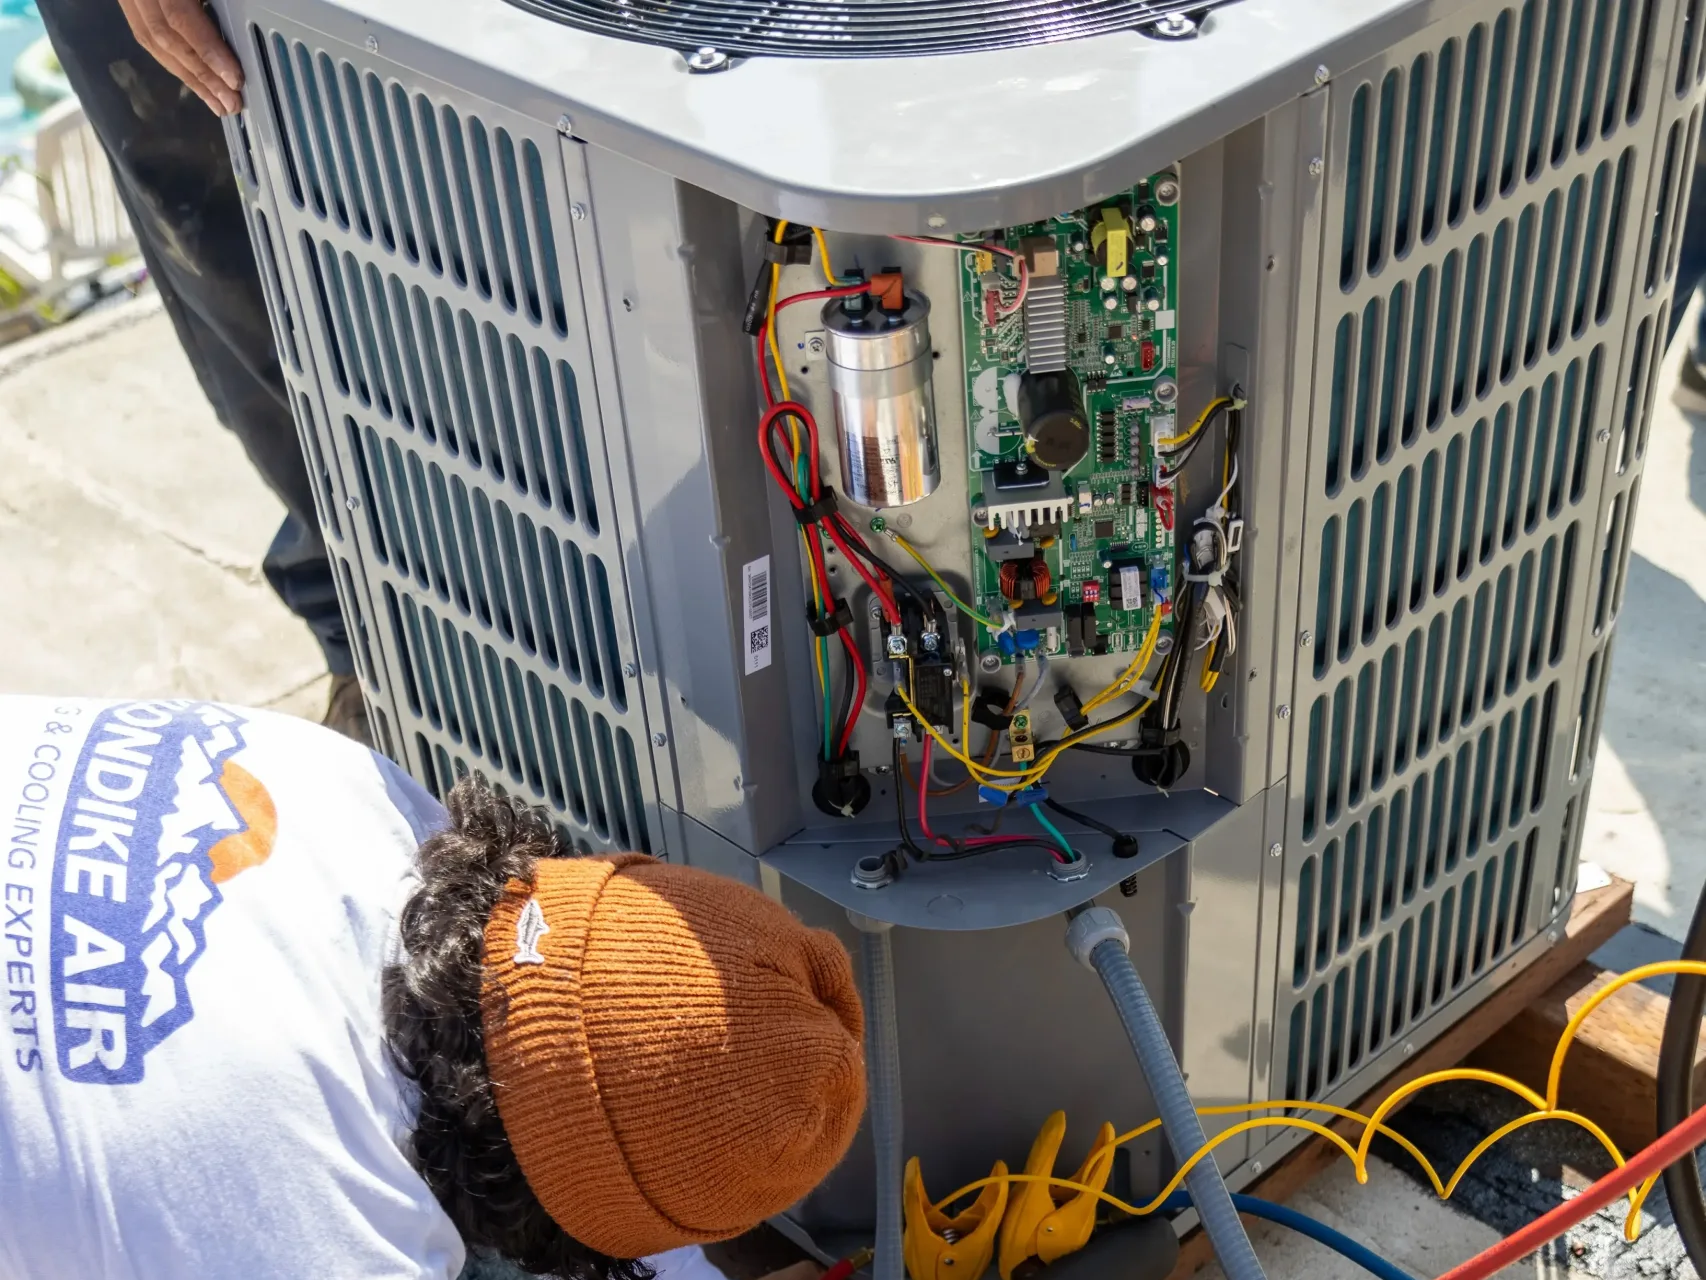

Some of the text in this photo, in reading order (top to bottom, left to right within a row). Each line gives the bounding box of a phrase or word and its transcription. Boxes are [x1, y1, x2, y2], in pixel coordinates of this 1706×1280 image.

[44, 721, 73, 735] &
[8, 744, 61, 869] COOLING
[4, 882, 43, 1072] EXPERTS
[63, 914, 128, 1071] AIR
